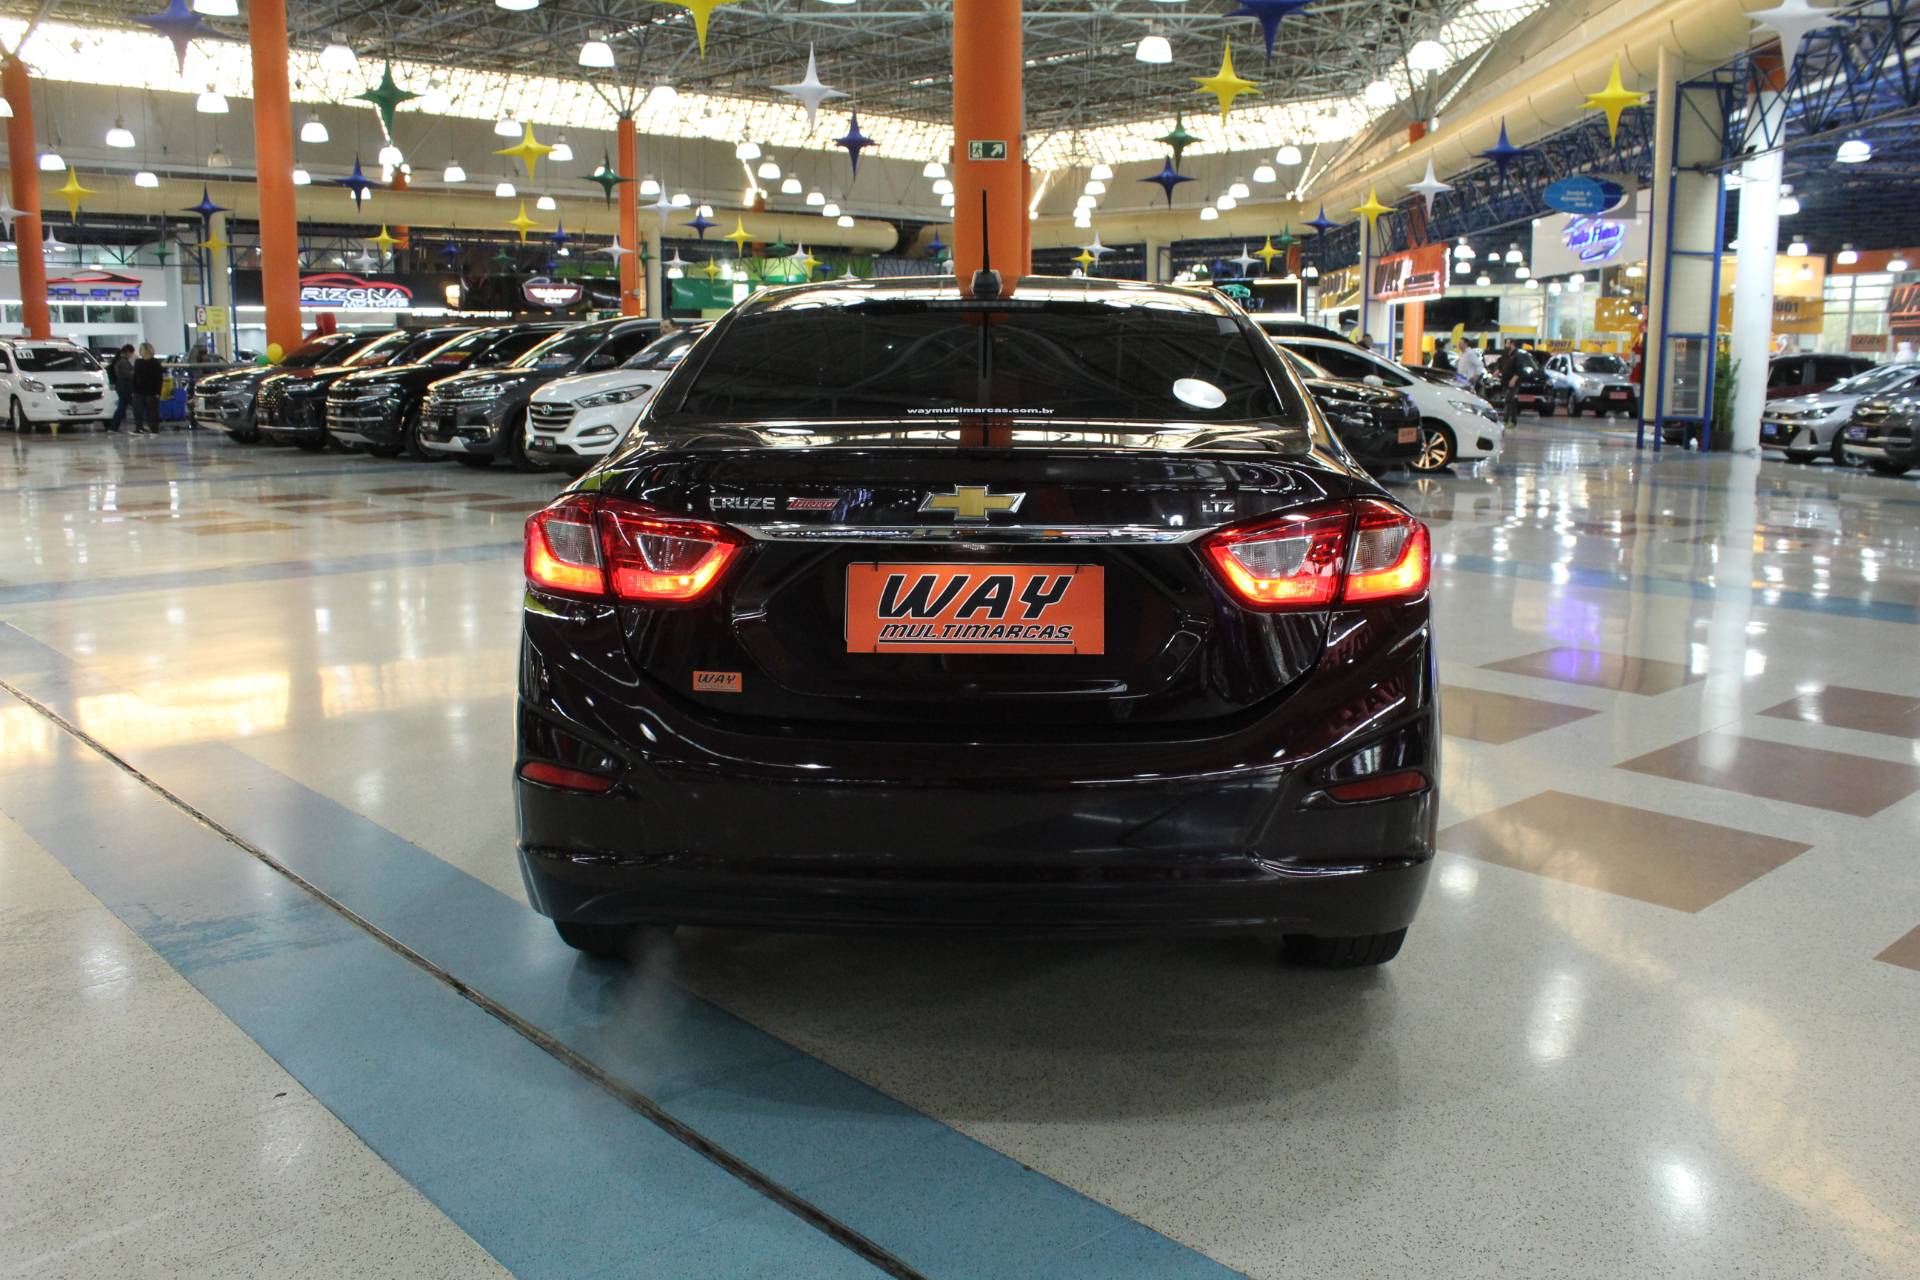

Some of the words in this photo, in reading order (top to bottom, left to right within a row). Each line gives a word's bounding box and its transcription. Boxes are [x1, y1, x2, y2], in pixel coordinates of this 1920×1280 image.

[299, 287, 402, 300] RIZONA
[709, 496, 776, 512] CRUZE
[1202, 500, 1236, 512] LTZ
[878, 574, 1074, 620] WAY
[880, 624, 1073, 639] MULTIMARCAS
[698, 673, 736, 684] WAY
